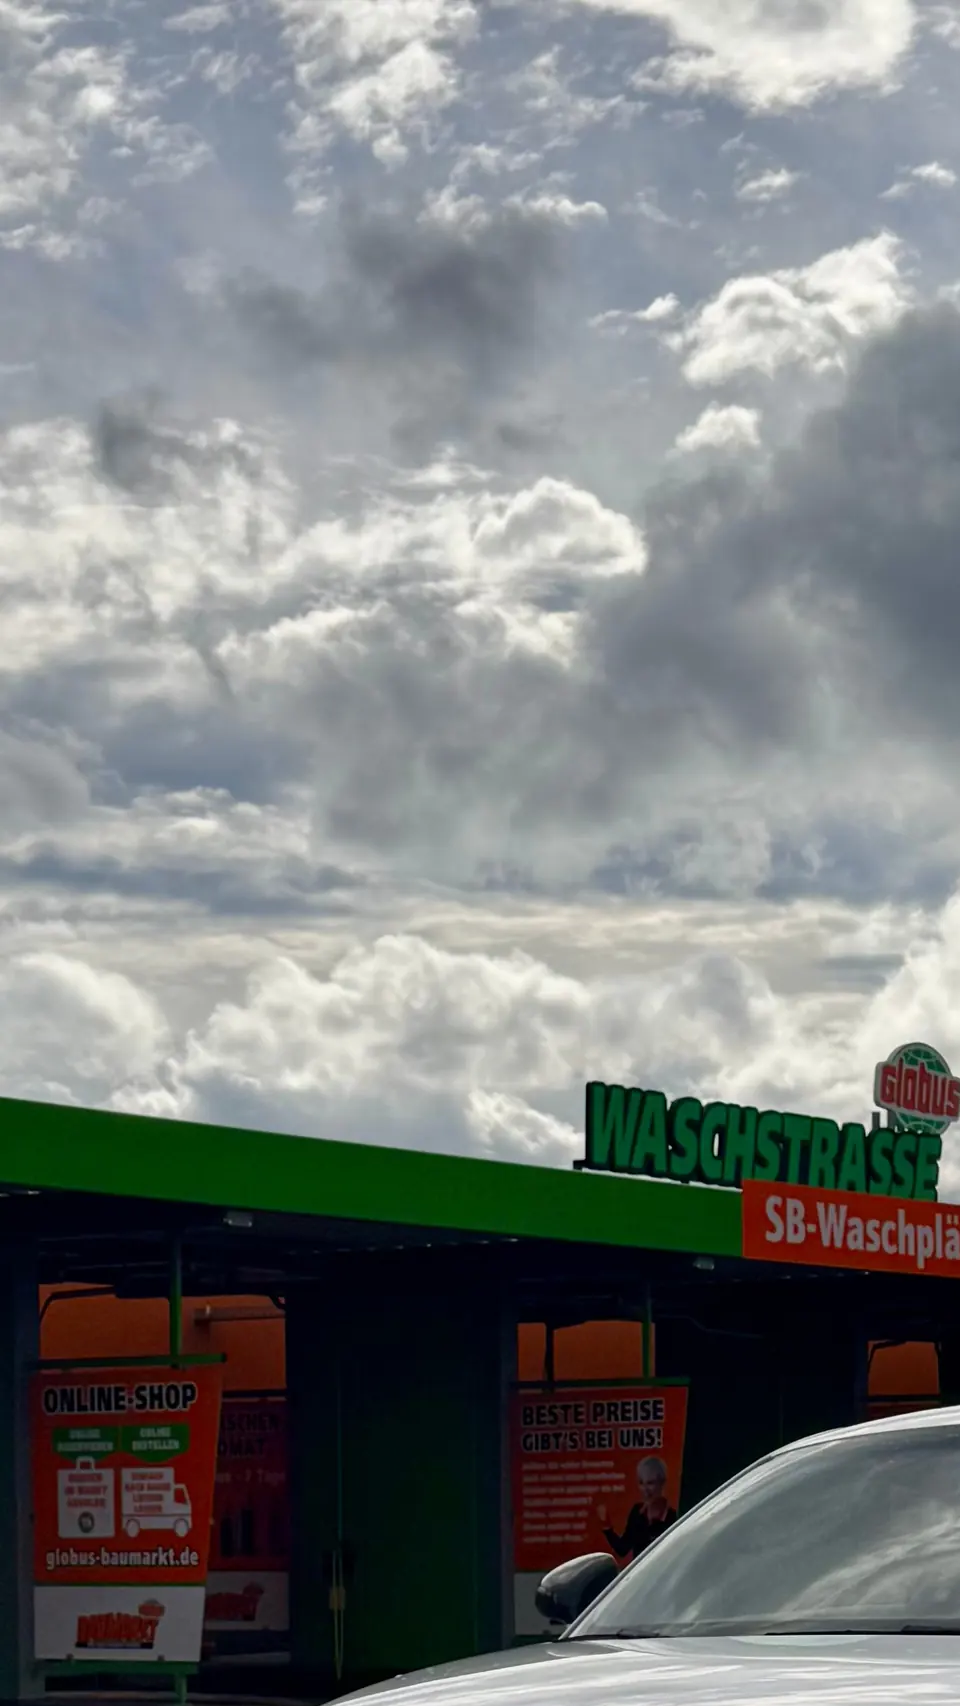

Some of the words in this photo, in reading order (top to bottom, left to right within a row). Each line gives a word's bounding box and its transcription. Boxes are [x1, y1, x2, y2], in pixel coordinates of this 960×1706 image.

[588, 1081, 942, 1201] WASCHSTRASSE
[43, 1383, 197, 1414] ONLINE-SHOP
[522, 1403, 585, 1427] BESTE
[592, 1399, 665, 1423] PREISE
[522, 1431, 580, 1452] GIBT'S
[586, 1430, 613, 1449] BEI
[620, 1428, 662, 1448] UNS!
[46, 1547, 199, 1570] globus-baumarkt.de
